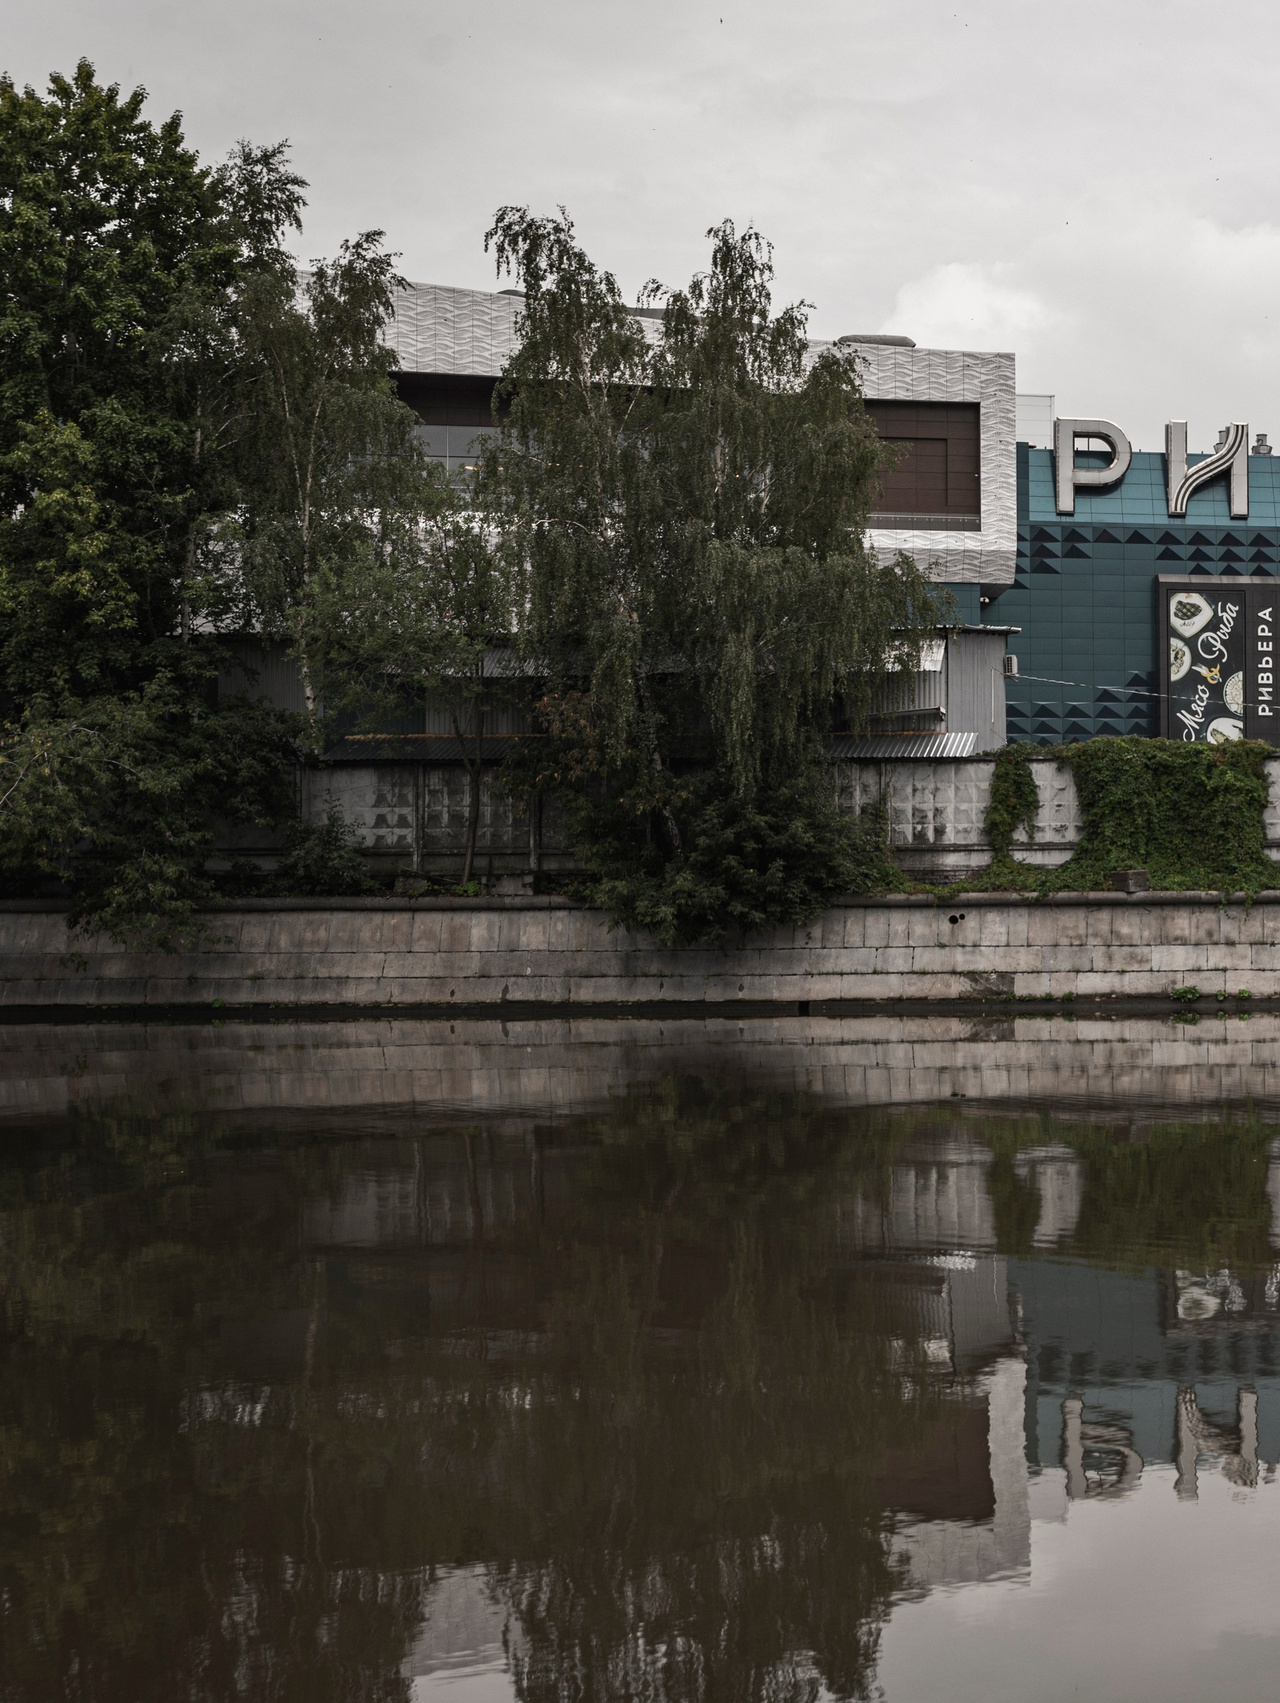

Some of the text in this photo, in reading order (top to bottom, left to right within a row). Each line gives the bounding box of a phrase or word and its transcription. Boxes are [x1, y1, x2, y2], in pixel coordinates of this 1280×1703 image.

[1176, 684, 1210, 742] Мясо
[1197, 601, 1240, 663] Рыба
[1258, 607, 1273, 716] РИВЬЕРА
